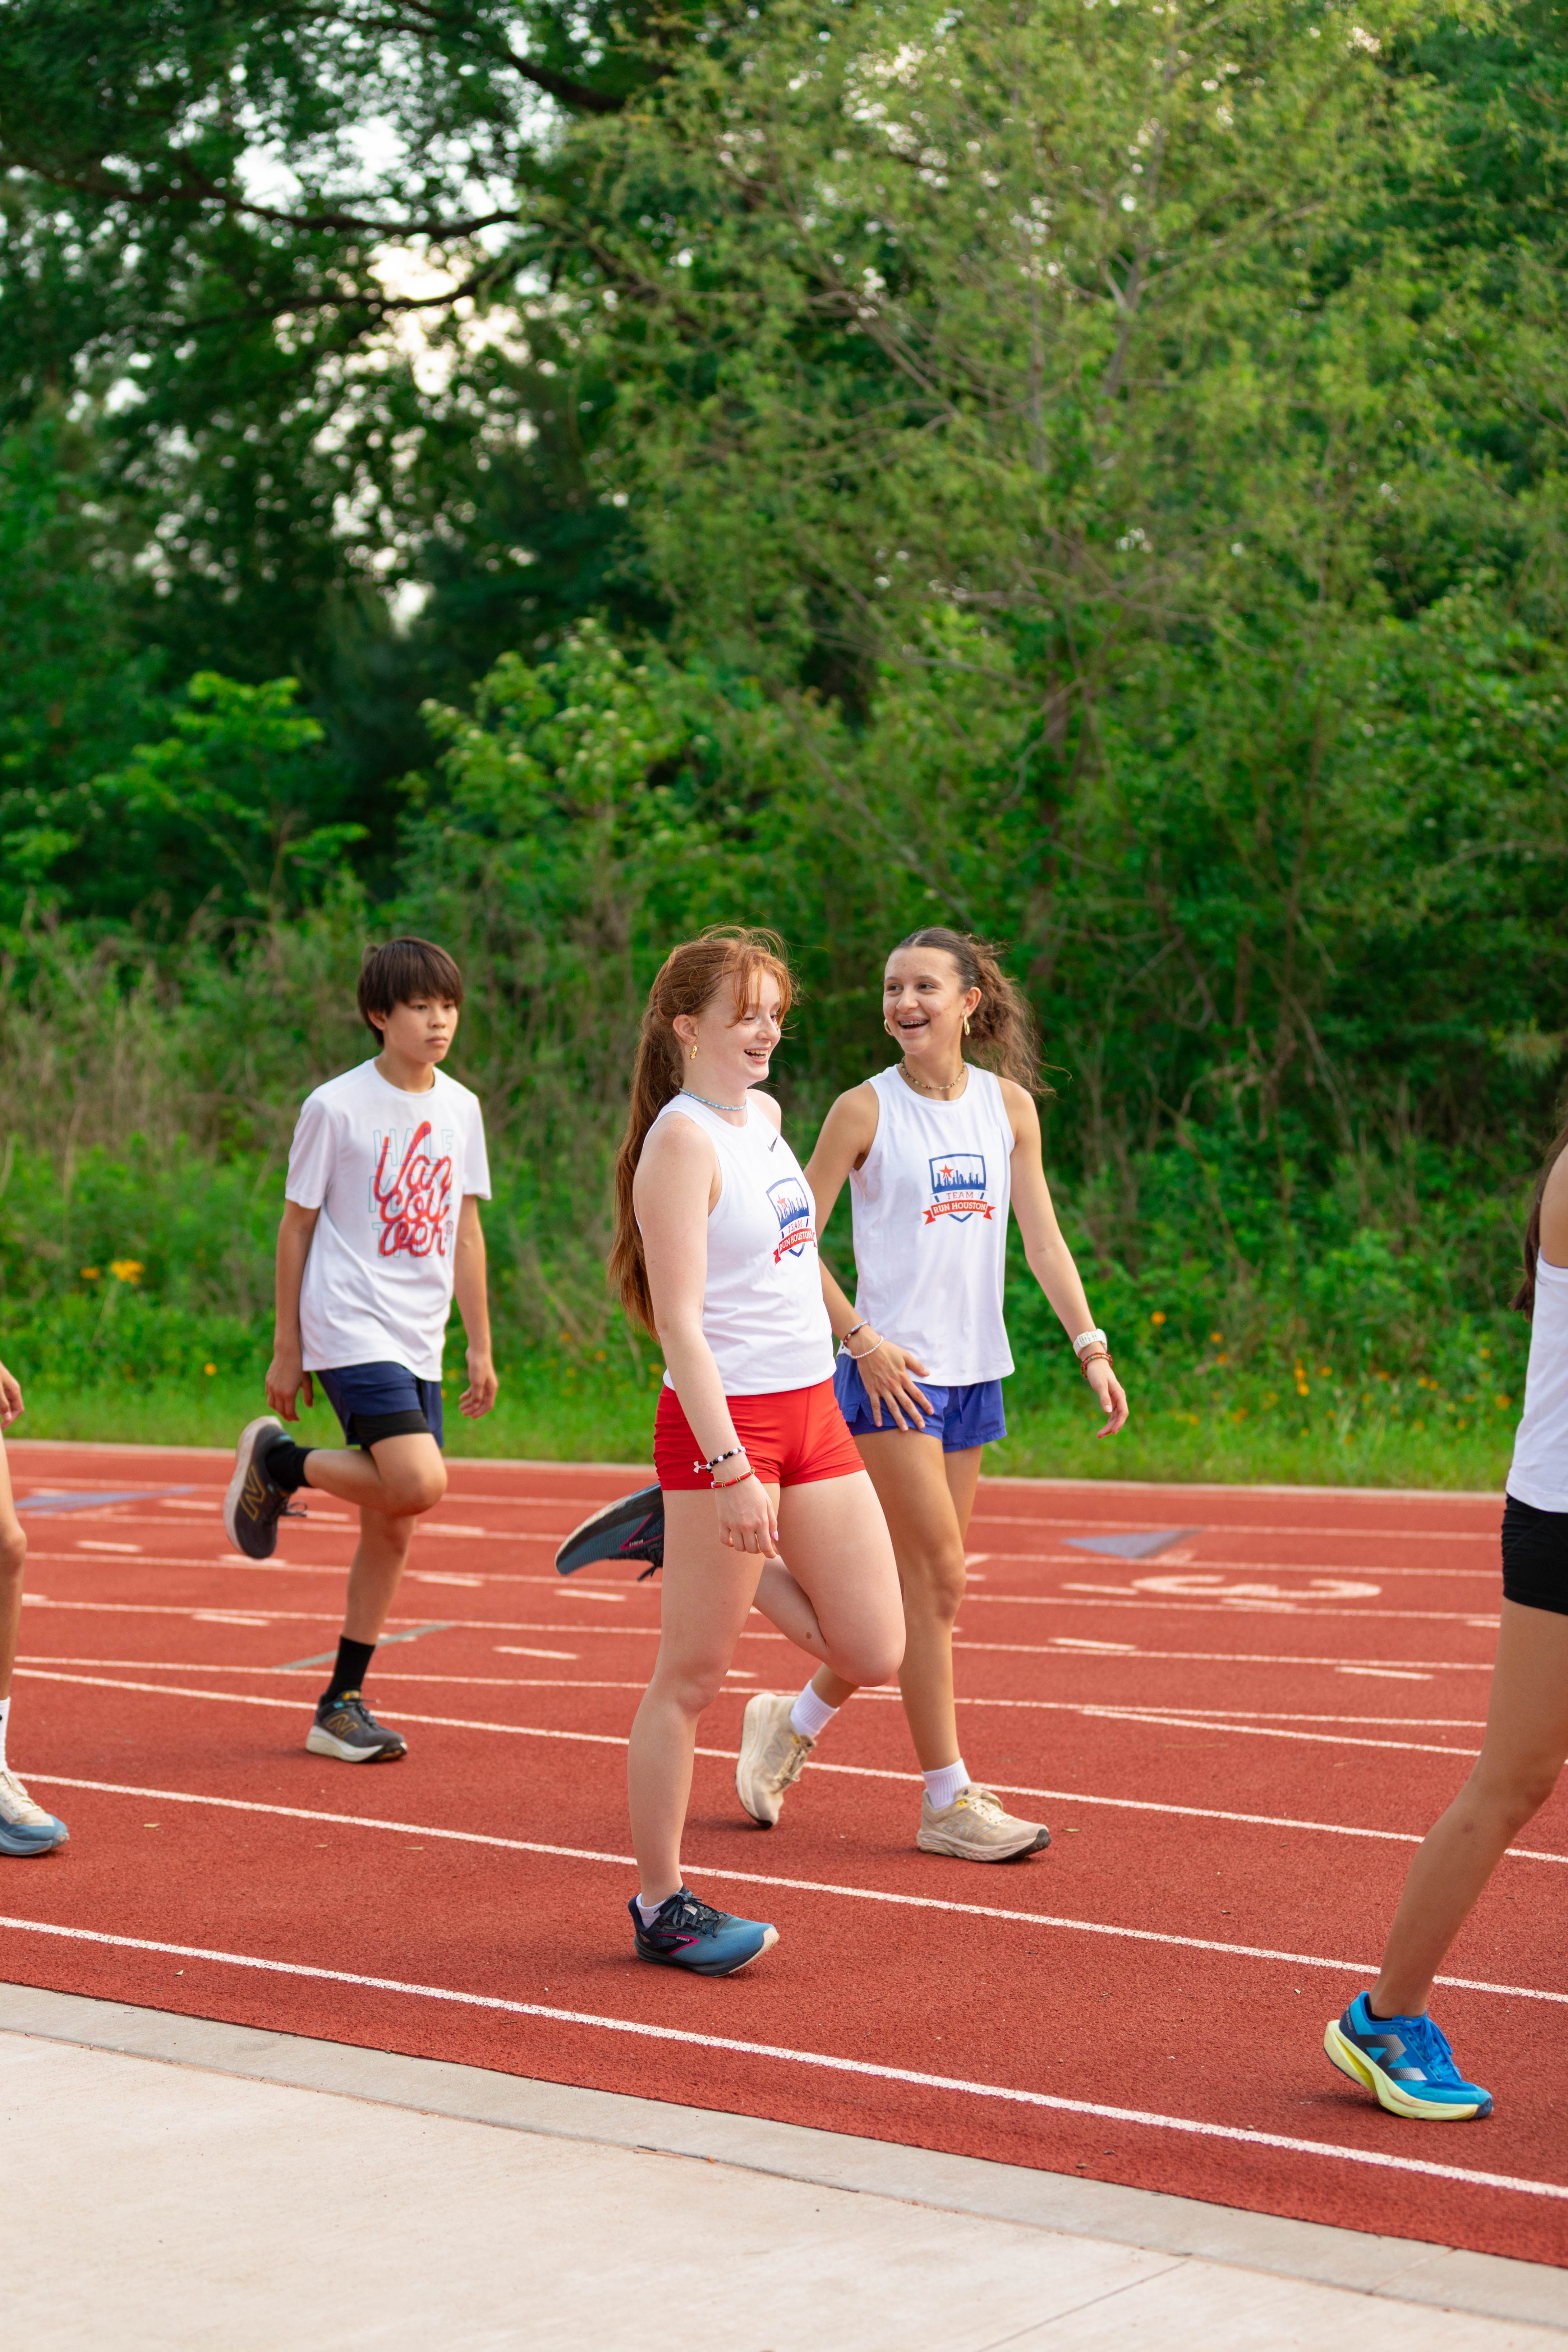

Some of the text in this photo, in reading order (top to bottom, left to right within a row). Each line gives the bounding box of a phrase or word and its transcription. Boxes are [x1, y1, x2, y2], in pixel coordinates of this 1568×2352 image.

[933, 1202, 986, 1214] RUN HOUSTON
[788, 1219, 802, 1233] TEAM
[780, 1232, 812, 1252] RUN HOUSTON
